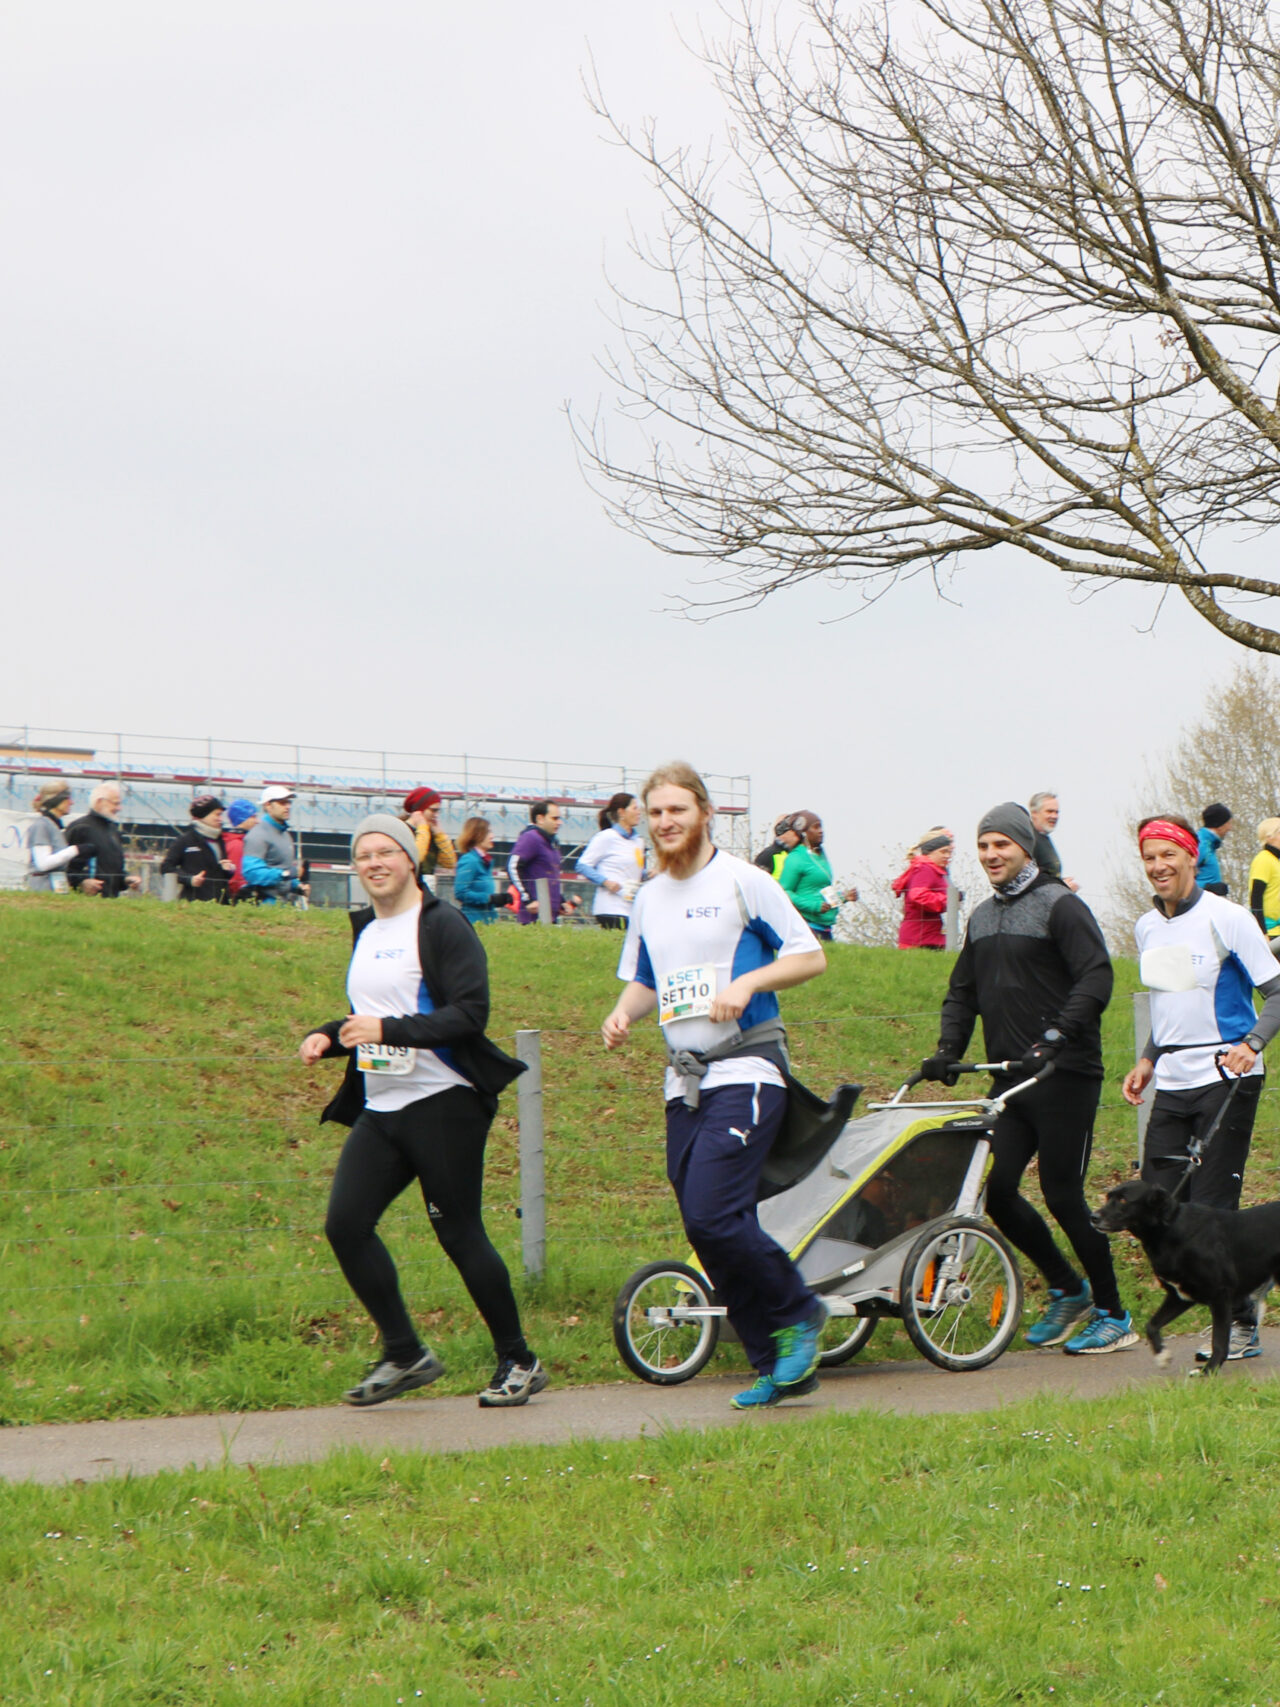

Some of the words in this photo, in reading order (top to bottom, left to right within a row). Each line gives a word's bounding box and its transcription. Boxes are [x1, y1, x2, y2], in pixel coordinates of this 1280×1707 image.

[695, 906, 721, 918] SET
[1192, 954, 1206, 965] ET
[675, 968, 704, 984] SET
[661, 983, 710, 1007] SET10
